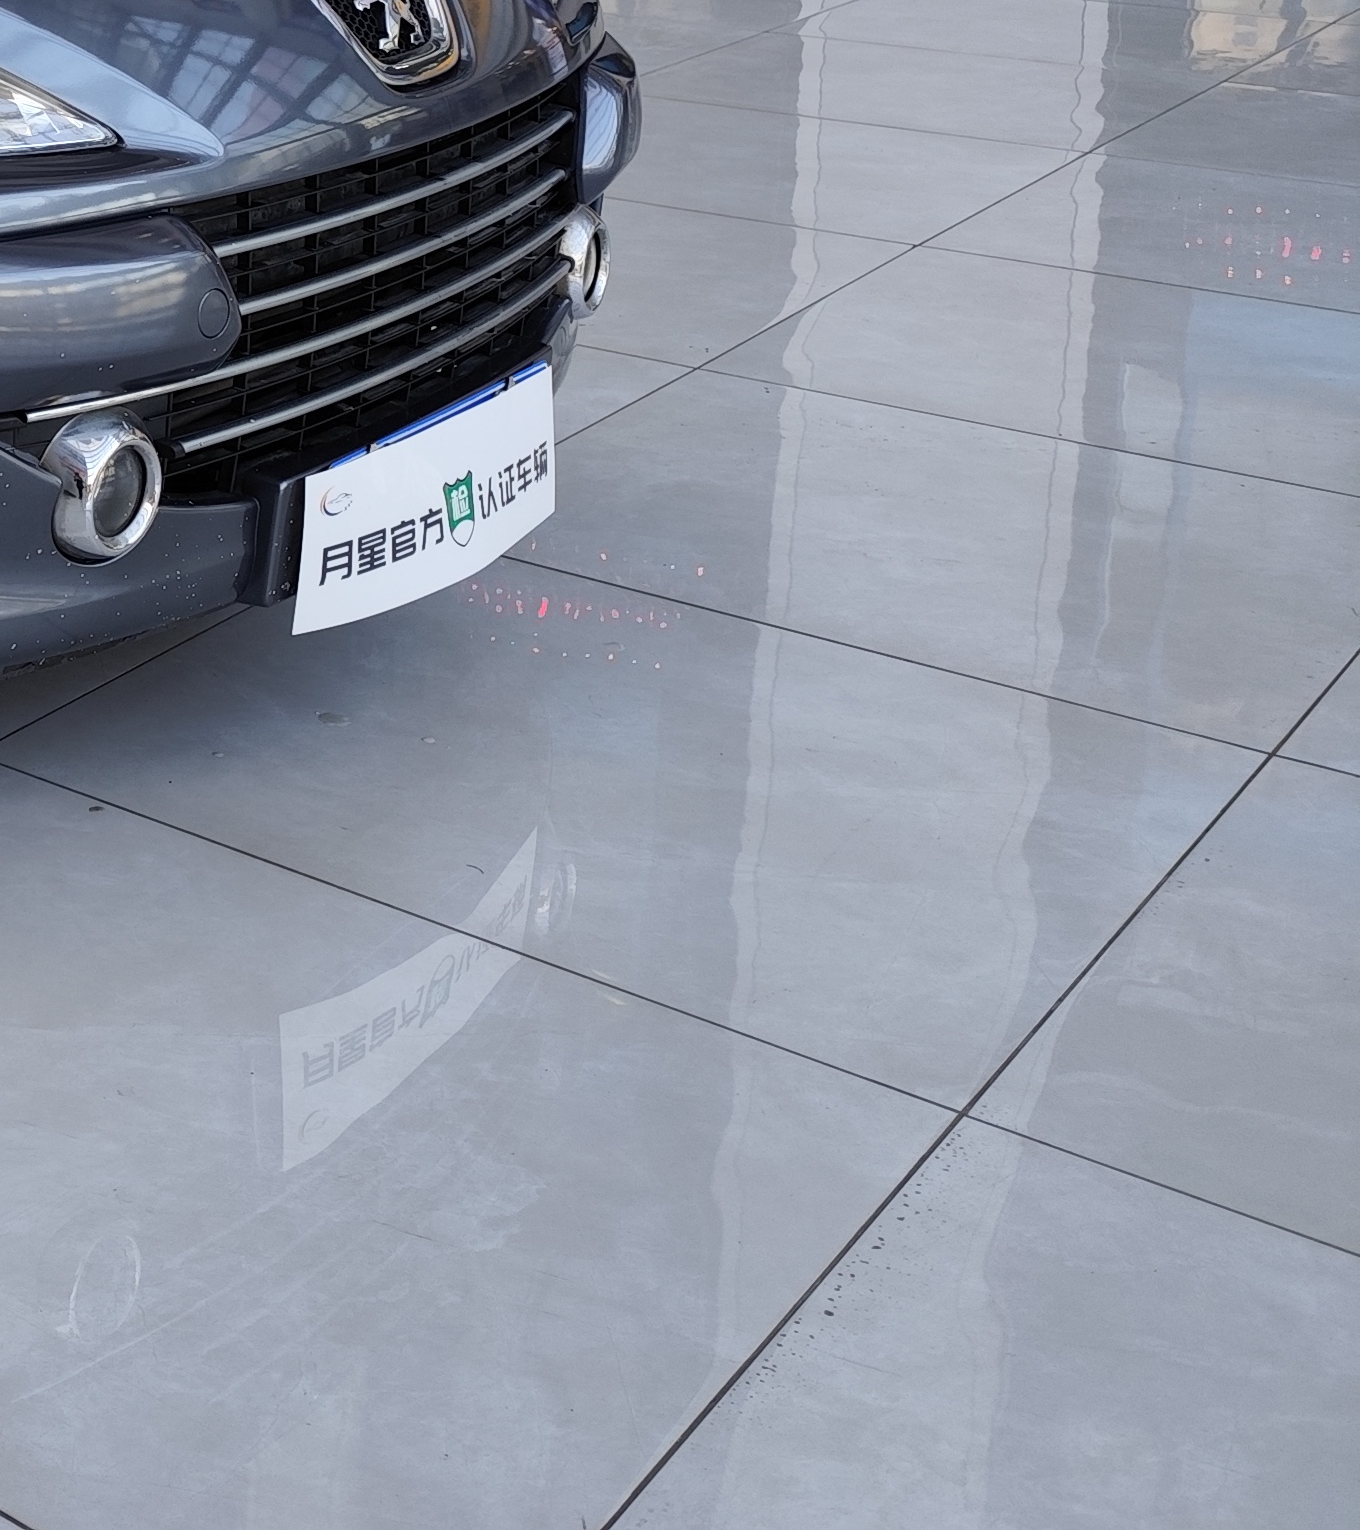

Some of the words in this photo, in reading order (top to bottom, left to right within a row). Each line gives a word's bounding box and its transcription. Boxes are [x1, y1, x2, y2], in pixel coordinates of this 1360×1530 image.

[319, 507, 444, 586] 月星官方
[478, 440, 548, 520] 认证车辆
